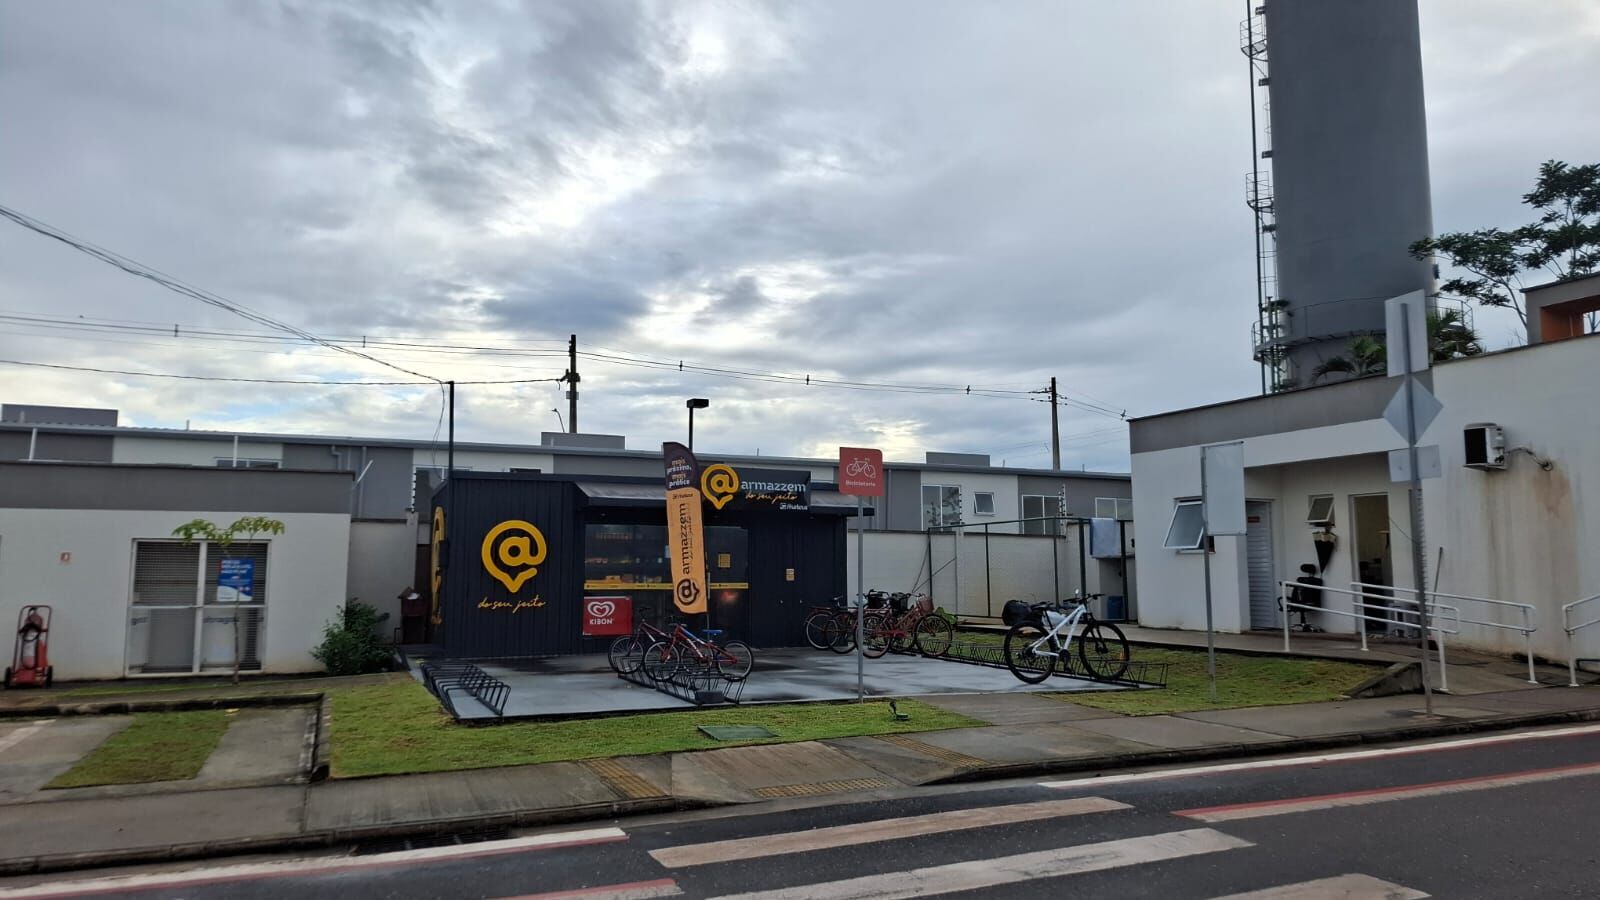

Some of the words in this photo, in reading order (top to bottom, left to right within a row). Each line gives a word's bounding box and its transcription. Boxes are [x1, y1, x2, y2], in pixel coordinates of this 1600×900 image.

[741, 481, 806, 492] armazzem
[745, 490, 756, 499] do
[771, 491, 798, 504] jeito
[680, 503, 690, 575] armazzem
[478, 597, 492, 608] do
[491, 601, 513, 610] seu
[512, 594, 546, 613] jeito
